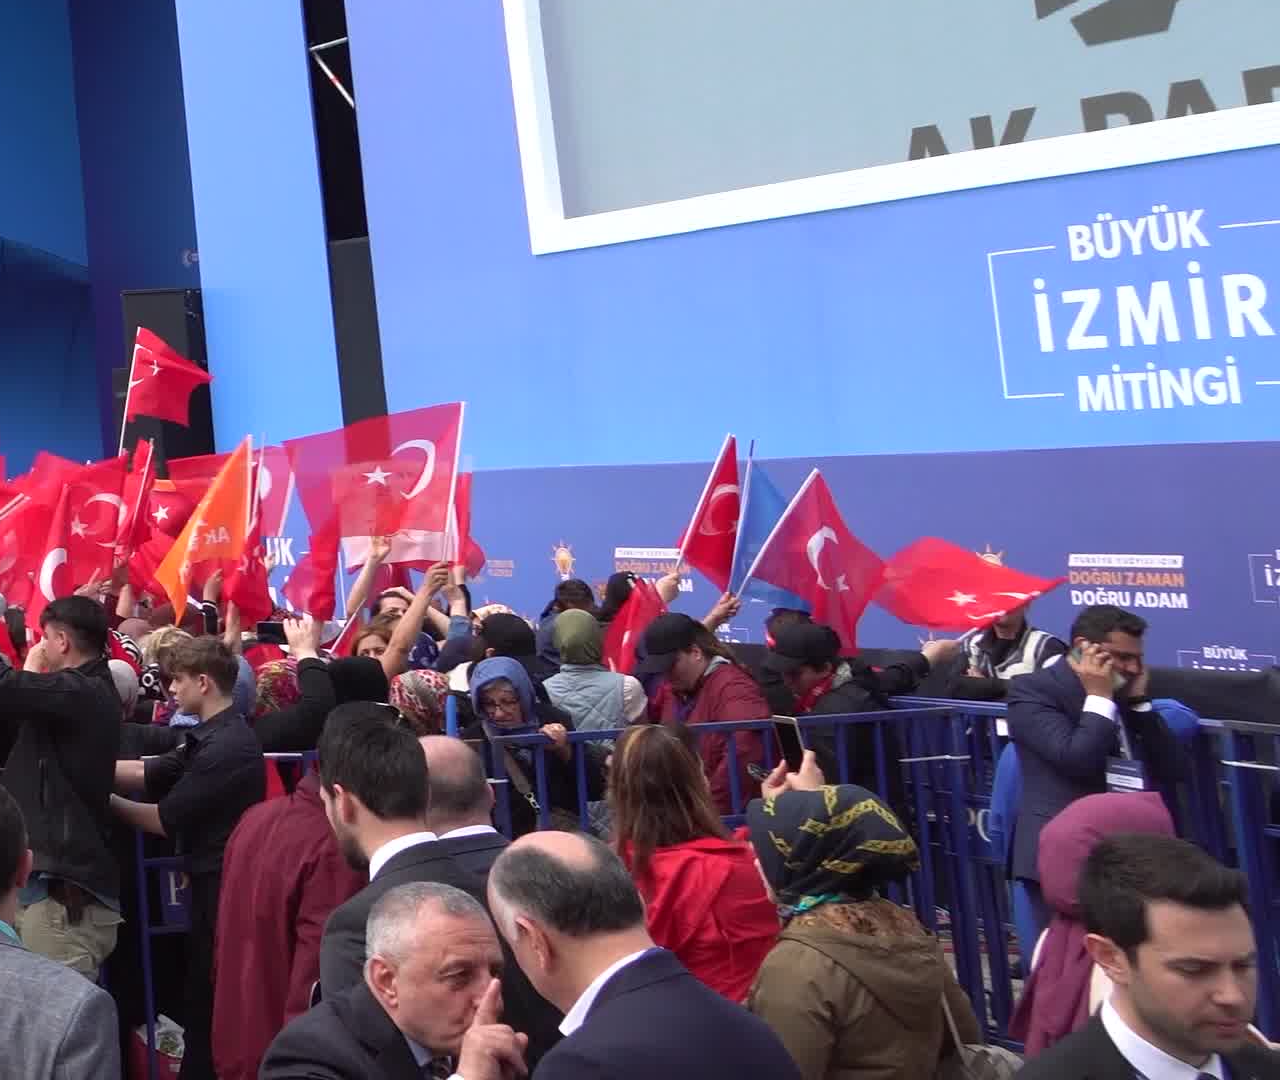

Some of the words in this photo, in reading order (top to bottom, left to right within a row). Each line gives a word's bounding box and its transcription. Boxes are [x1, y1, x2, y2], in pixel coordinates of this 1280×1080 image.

[1067, 205, 1211, 262] BÜYÜK
[1033, 261, 1276, 353] İZMİR
[1077, 355, 1242, 413] MİTİNGİ
[1069, 568, 1122, 586] DOĞRU
[1126, 571, 1185, 588] ZAMAN
[1070, 587, 1131, 607] DOĞRU
[1133, 590, 1189, 609] ADAM
[1202, 644, 1249, 661] BÜYÜK
